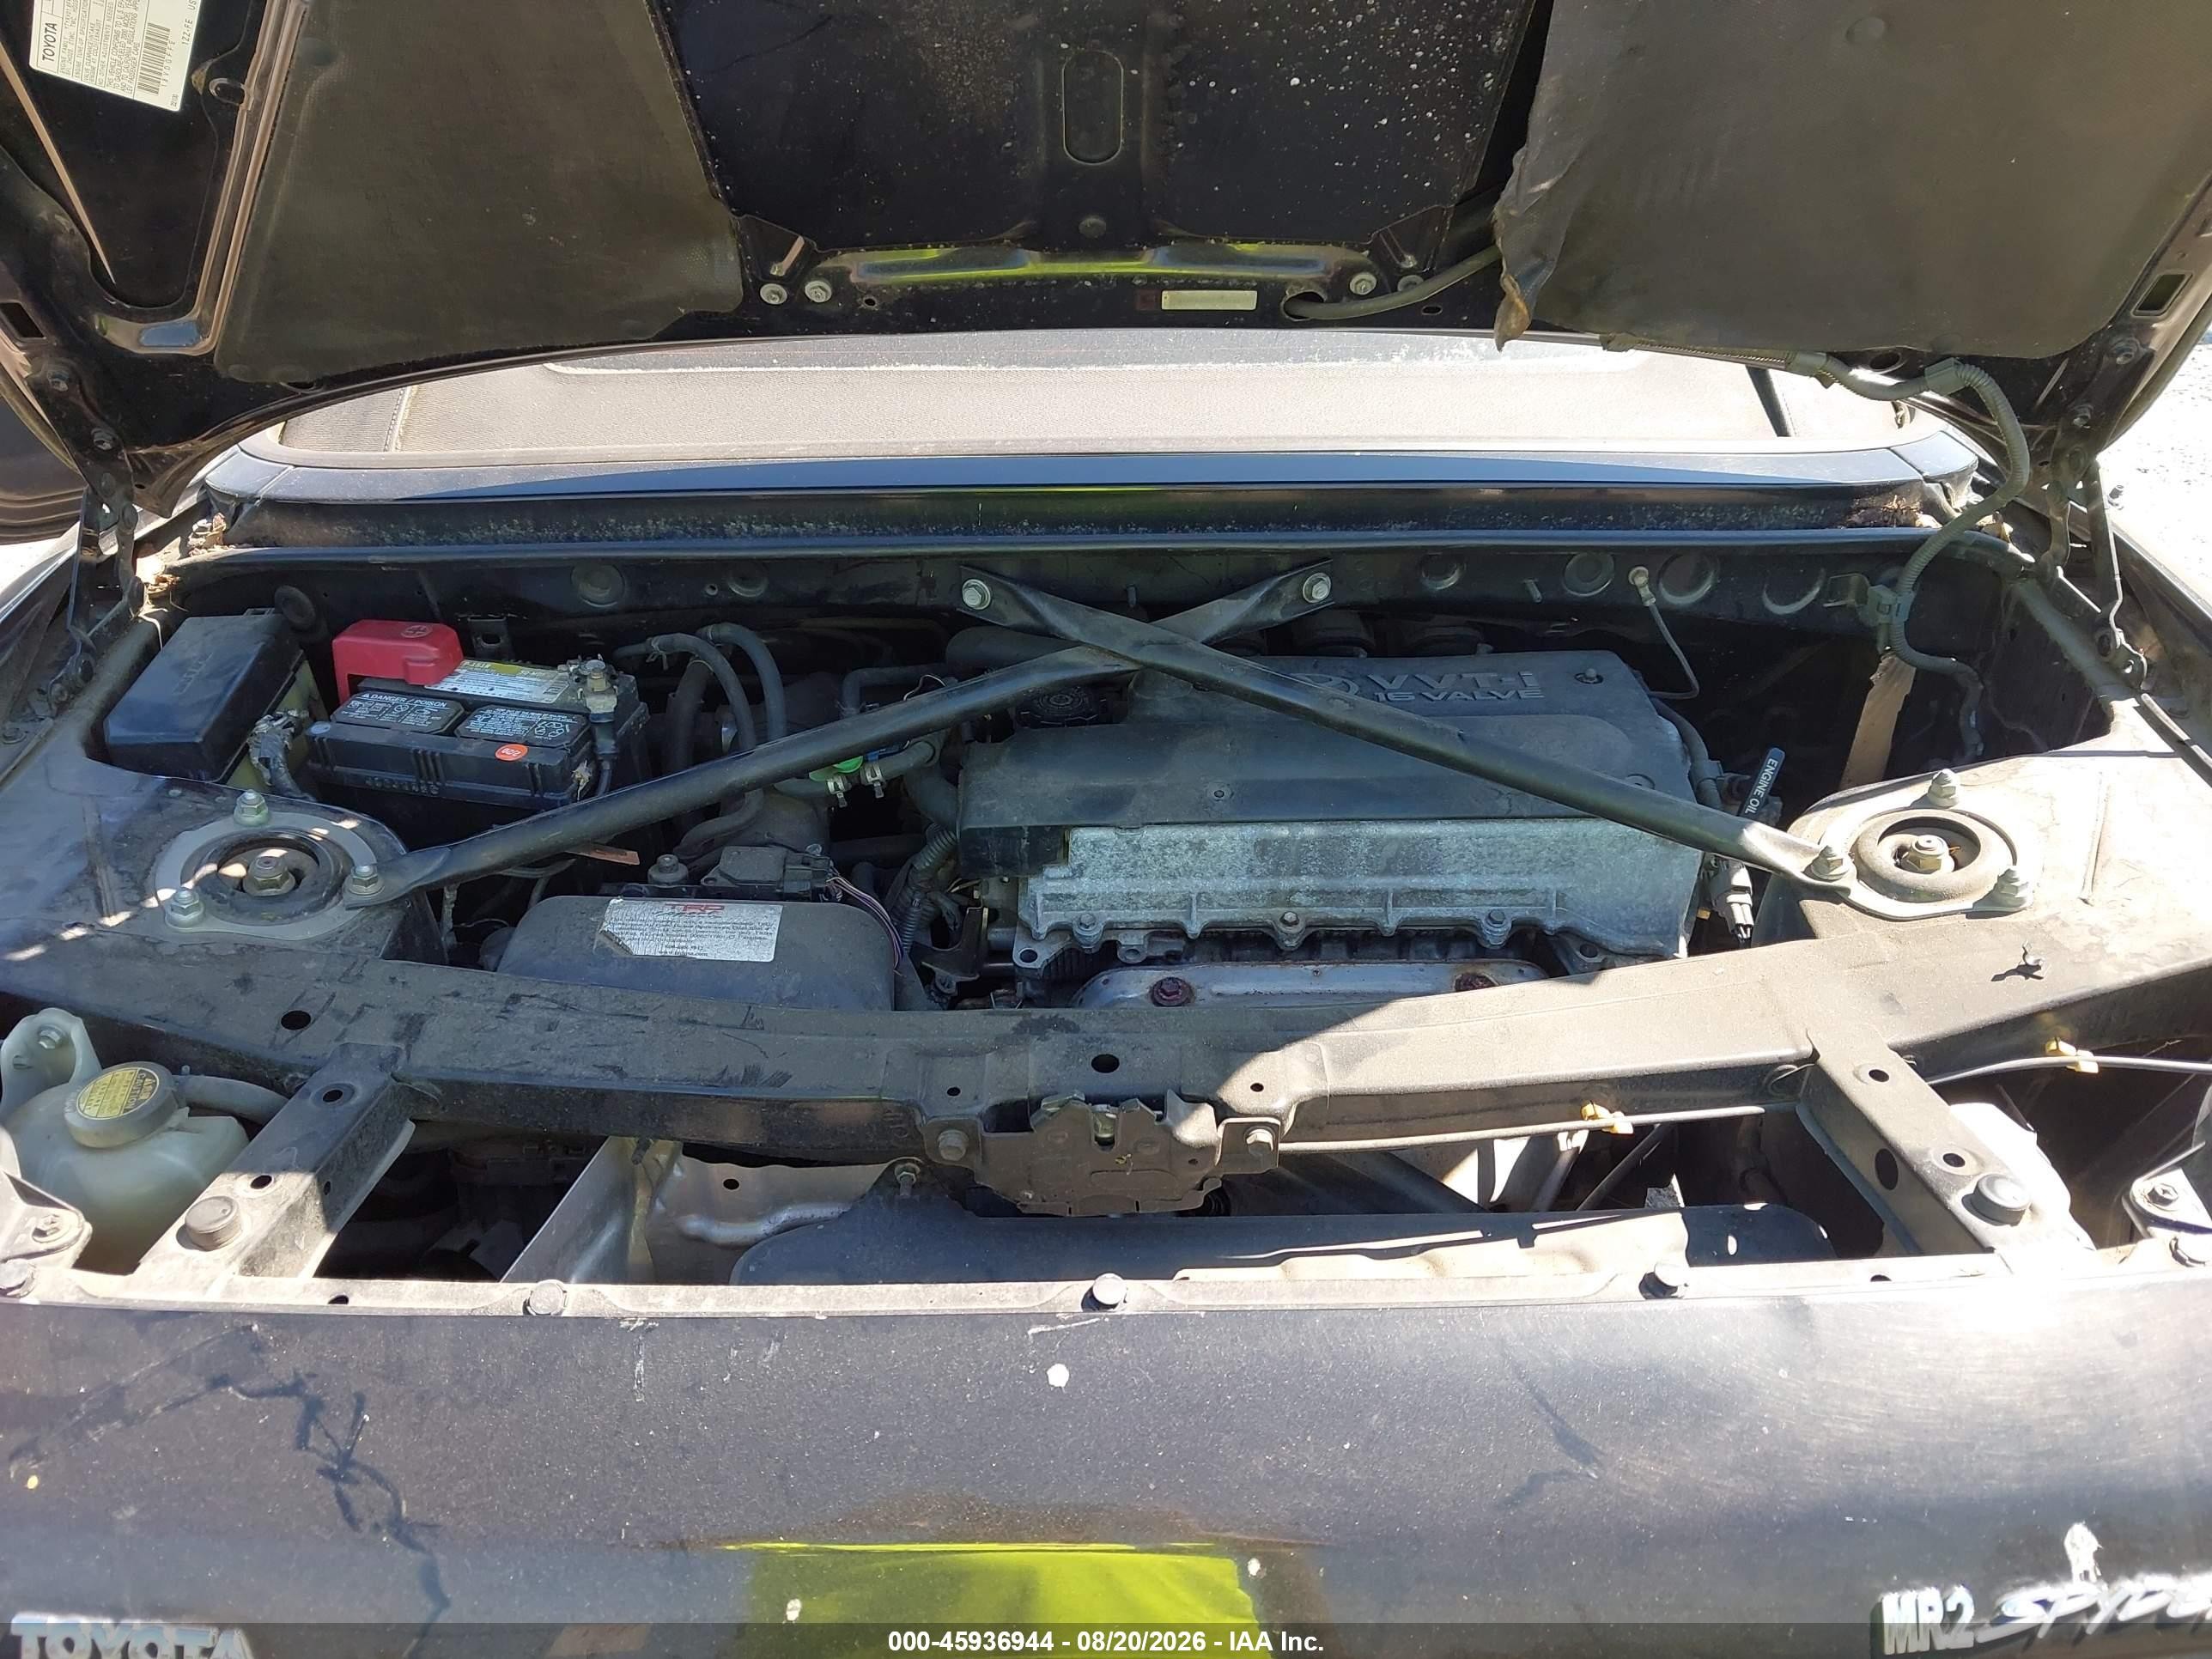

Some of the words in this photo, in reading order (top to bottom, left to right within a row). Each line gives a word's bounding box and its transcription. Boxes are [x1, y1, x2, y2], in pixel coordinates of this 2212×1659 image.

[41, 21, 57, 63] TOYOTA
[181, 18, 193, 45] 1ZZ-FE
[370, 693, 407, 704] DANGER
[413, 698, 448, 708] POISON
[1373, 690, 1415, 702] 16
[1420, 688, 1546, 702] VALVE
[1753, 758, 1778, 798] ENGINE
[1745, 799, 1759, 814] OIL
[10, 1612, 255, 1659] TOYOTA
[1881, 1585, 1976, 1656] MR2
